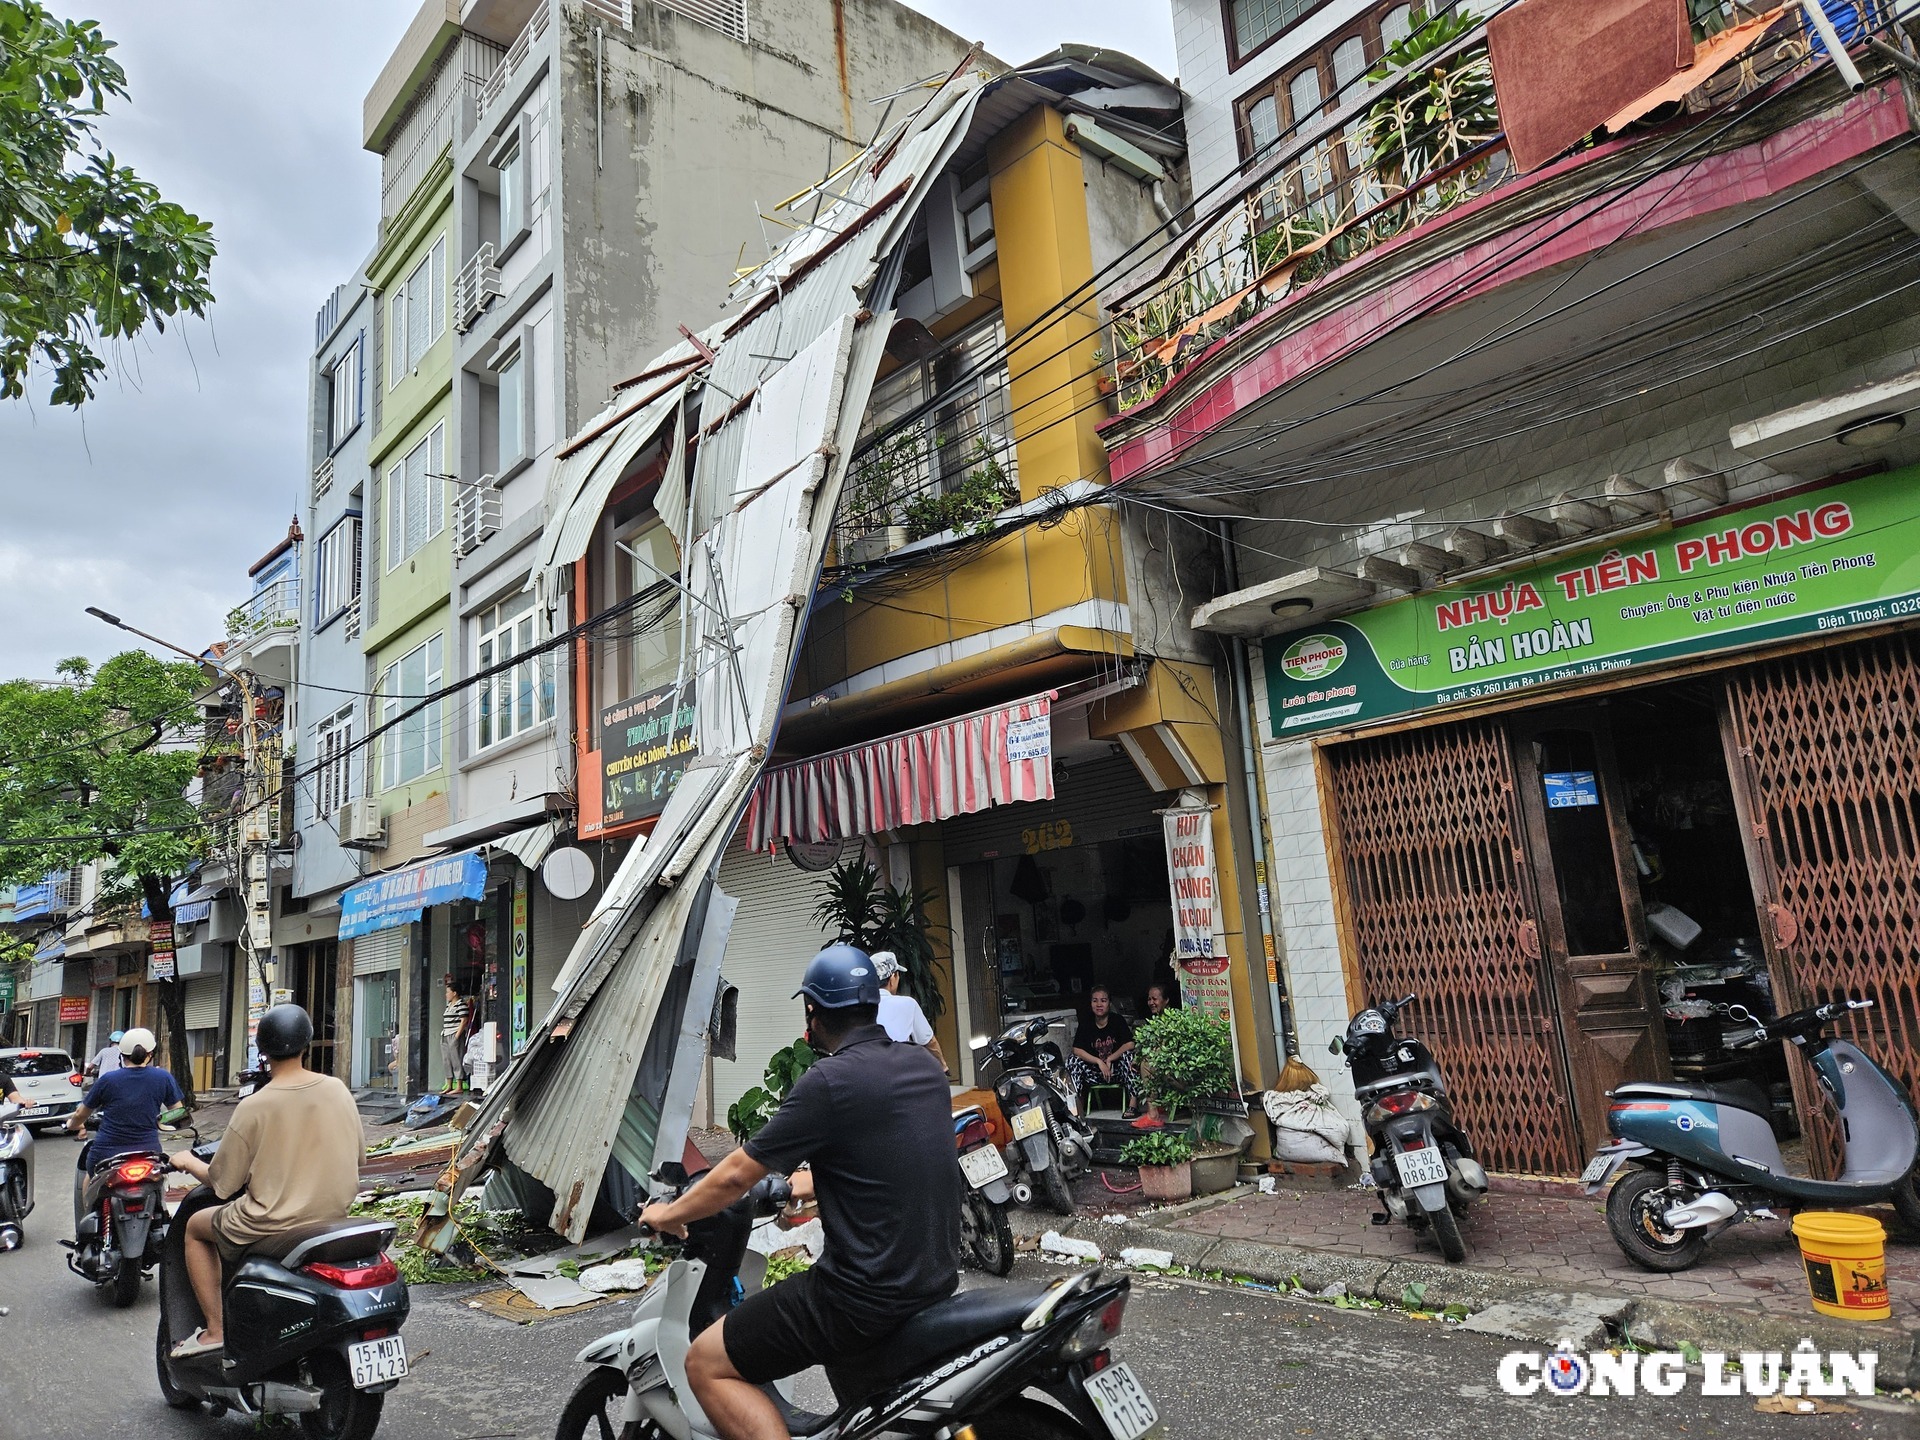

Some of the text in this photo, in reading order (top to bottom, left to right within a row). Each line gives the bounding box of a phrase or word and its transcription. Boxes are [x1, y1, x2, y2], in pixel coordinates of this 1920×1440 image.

[1436, 502, 1853, 632] NHỰA TIỀN PHONG
[1621, 553, 1876, 619] Chuyên: Ống & Phụ kiện Nhựa Tiền Phong
[1693, 591, 1797, 623] Vật tư điện nước
[1817, 614, 1846, 629] Điện
[1849, 605, 1888, 621] Thoại:
[1309, 646, 1344, 663] PHONG
[1449, 618, 1594, 673] BẢN HOÀN
[1306, 663, 1323, 671] PLASTIC
[1282, 695, 1306, 709] Luôn
[1325, 684, 1357, 702] phong
[1470, 686, 1482, 698] Số
[1484, 682, 1501, 695] 260
[1021, 819, 1074, 855] 262
[1172, 842, 1204, 868] CHÂN
[1403, 1151, 1436, 1170] 15-B2
[1403, 1164, 1444, 1185] 088.26
[364, 1301, 396, 1312] VINFAST
[356, 1339, 401, 1364] 15-MD1
[356, 1357, 406, 1384] 674.23
[1095, 1366, 1135, 1407] 16-P9
[1113, 1395, 1154, 1439] 1745
